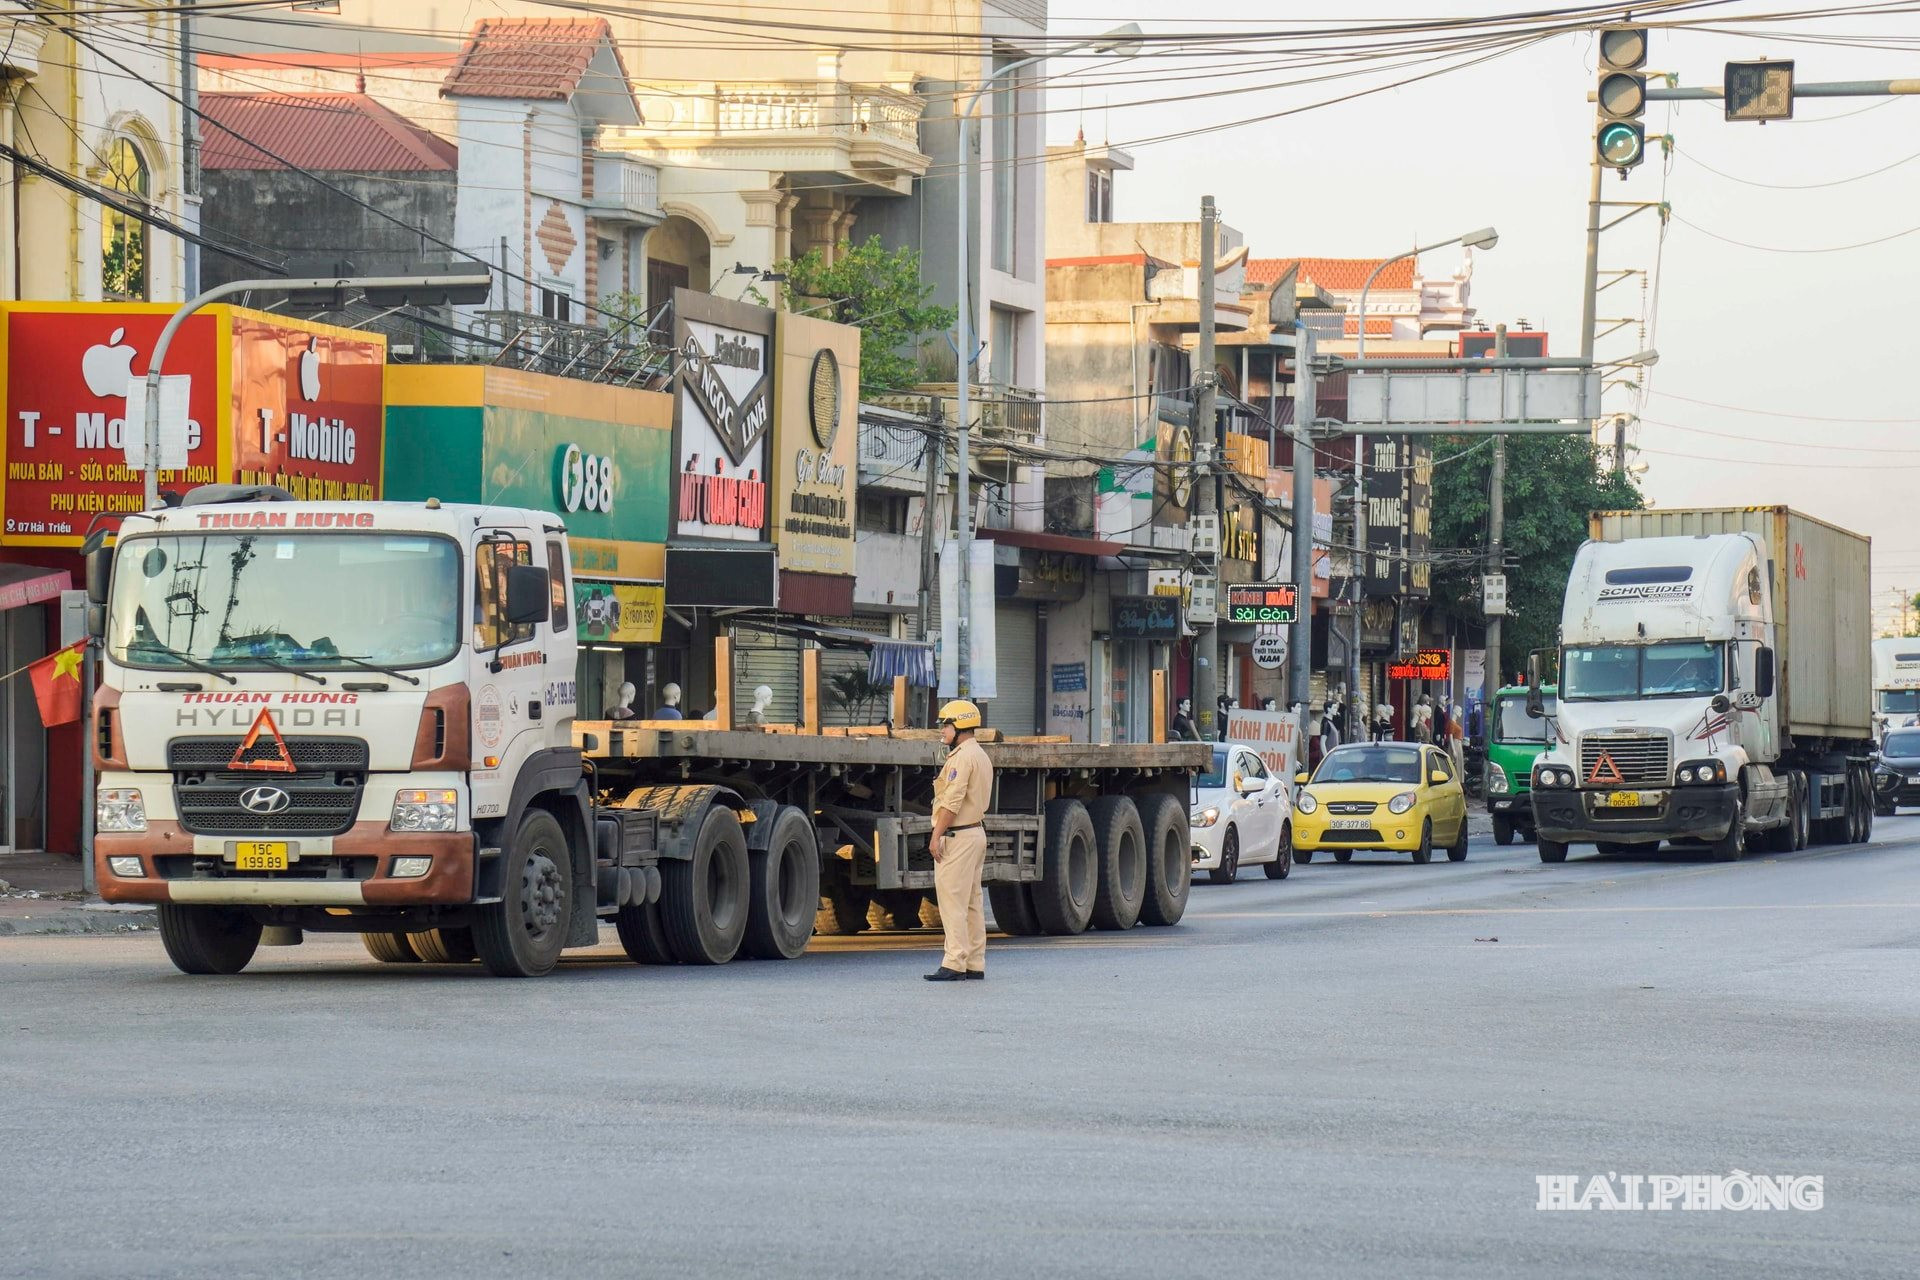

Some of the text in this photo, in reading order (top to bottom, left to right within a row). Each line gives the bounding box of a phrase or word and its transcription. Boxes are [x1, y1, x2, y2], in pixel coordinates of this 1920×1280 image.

[714, 333, 760, 371] Fashion
[701, 365, 733, 436] NGỌC
[19, 411, 40, 448] T
[76, 412, 201, 449] Moe
[742, 395, 767, 448] LINH
[291, 412, 356, 465] Mobile
[1374, 435, 1397, 472] THỜI
[9, 462, 35, 480] MUA
[39, 457, 63, 481] BÁN
[80, 457, 103, 482] SỬA
[51, 490, 144, 514] PHỤ KIỆN CHÍNH
[1368, 497, 1400, 527] TRANG
[18, 523, 29, 532] 07
[196, 511, 375, 529] THUẬN HƯNG
[1231, 586, 1294, 606] KÍNH MẮT
[1600, 584, 1693, 597] SCHNEIDER
[1236, 607, 1290, 620] Sài Gòn
[522, 650, 542, 670] HƯNG
[1258, 655, 1280, 663] NAM
[182, 692, 358, 706] THUẬN HƯNG
[176, 709, 360, 727] HYUNDAI
[1229, 716, 1294, 743] KÍNH MẮT
[252, 844, 273, 855] 15C
[243, 857, 282, 868] 199.89
